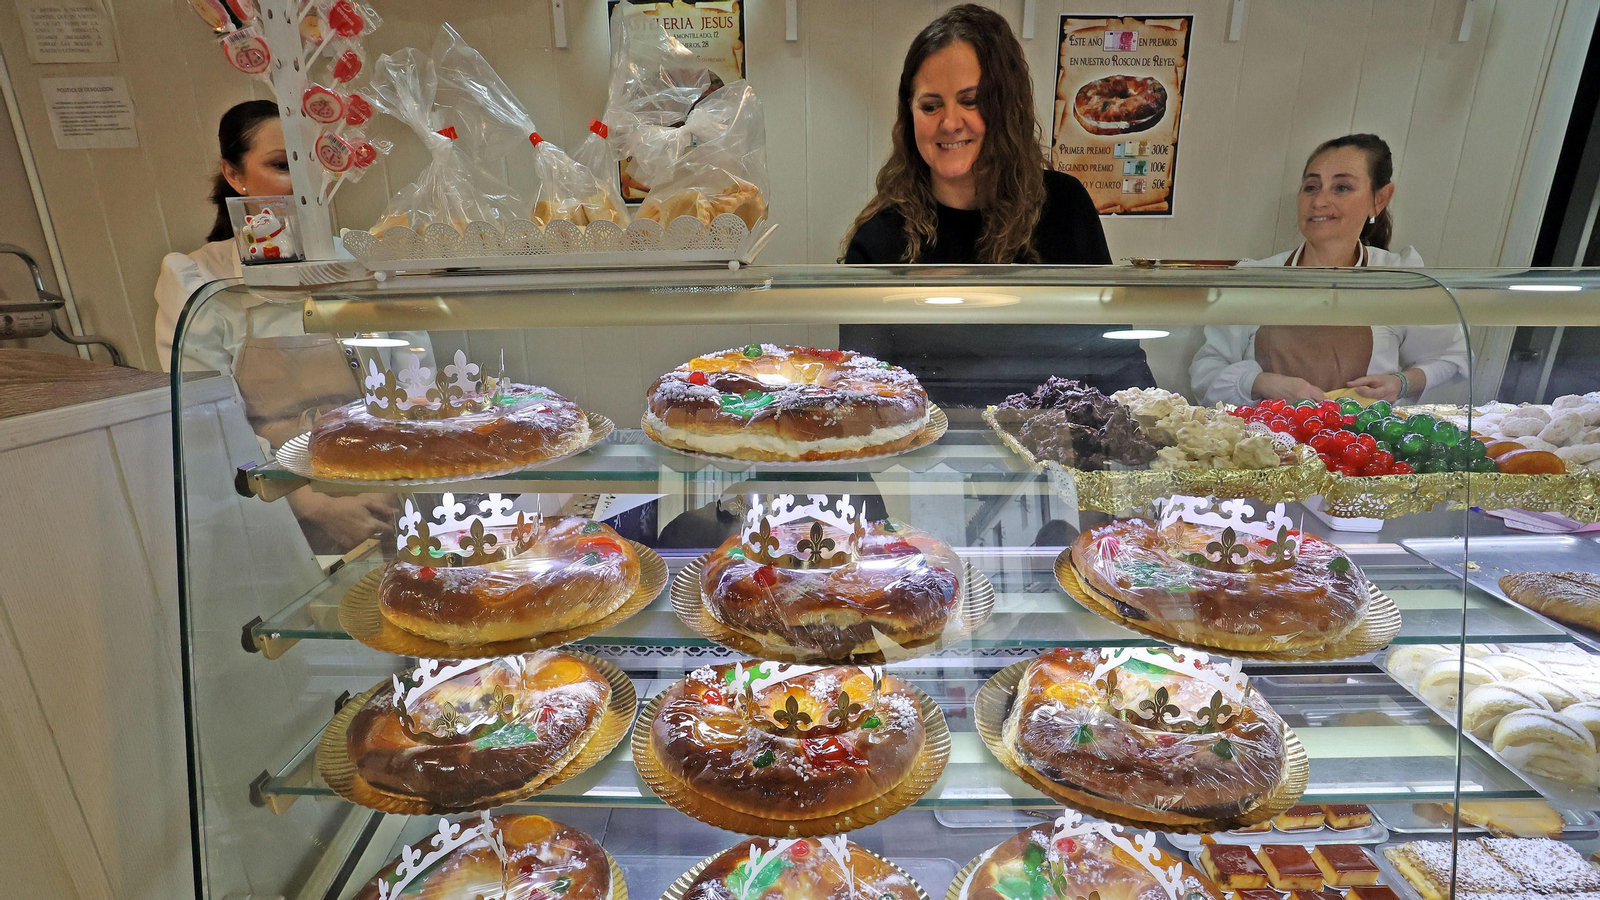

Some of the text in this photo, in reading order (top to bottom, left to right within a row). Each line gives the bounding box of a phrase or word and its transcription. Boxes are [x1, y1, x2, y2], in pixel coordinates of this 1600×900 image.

[700, 16, 734, 30] JESUS
[1069, 34, 1086, 46] ESTE
[1088, 36, 1102, 46] AÑO
[1149, 38, 1178, 46] PREMIOS
[1070, 55, 1175, 66] EN NUESTRO ROSCON DE REYES
[1059, 144, 1169, 155] PRIMER PREMIO 300€
[1058, 161, 1166, 172] SEGUNDO PREMIO 100€
[1095, 181, 1122, 189] CUARTO
[1152, 179, 1165, 189] 50€
